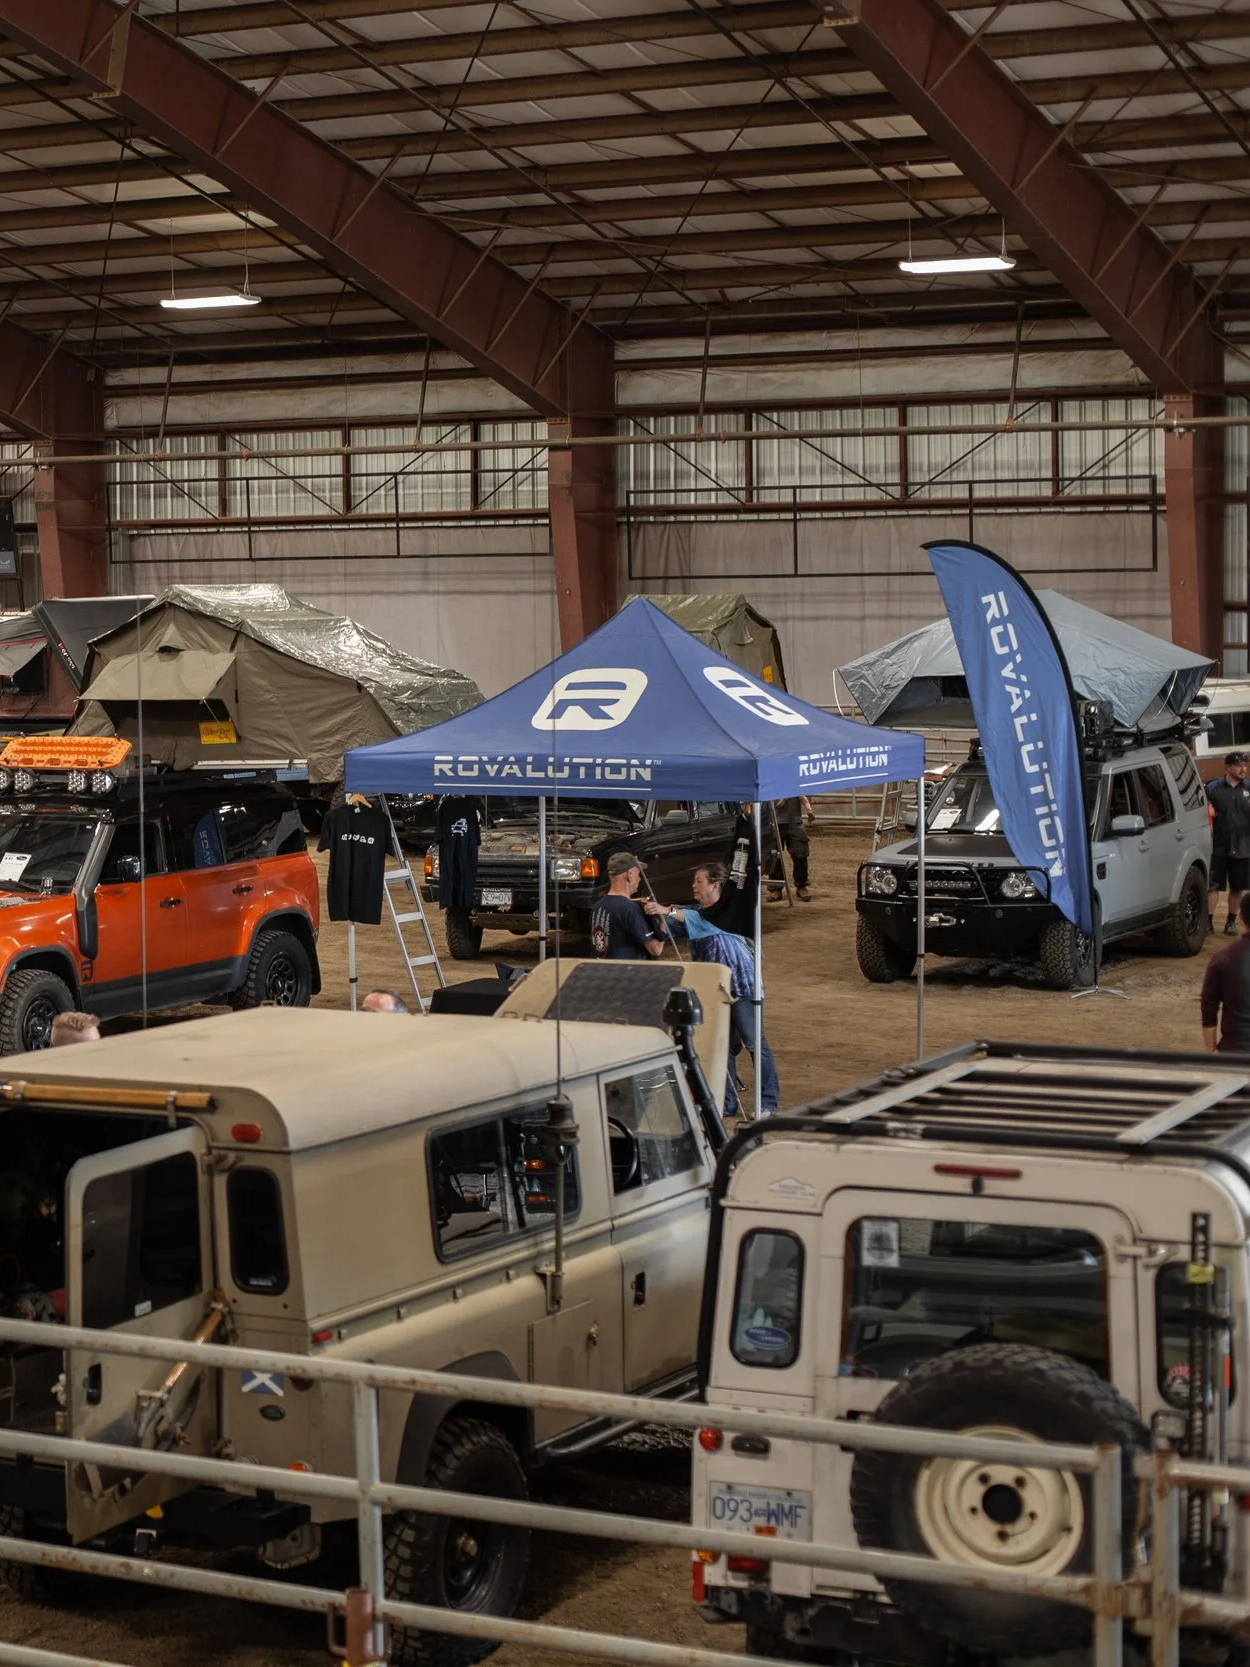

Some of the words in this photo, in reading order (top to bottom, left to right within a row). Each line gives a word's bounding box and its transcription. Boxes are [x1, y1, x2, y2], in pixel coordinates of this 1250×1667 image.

[981, 590, 1067, 878] ROVALUTION
[711, 1496, 754, 1523] 093
[766, 1500, 808, 1529] WMF
